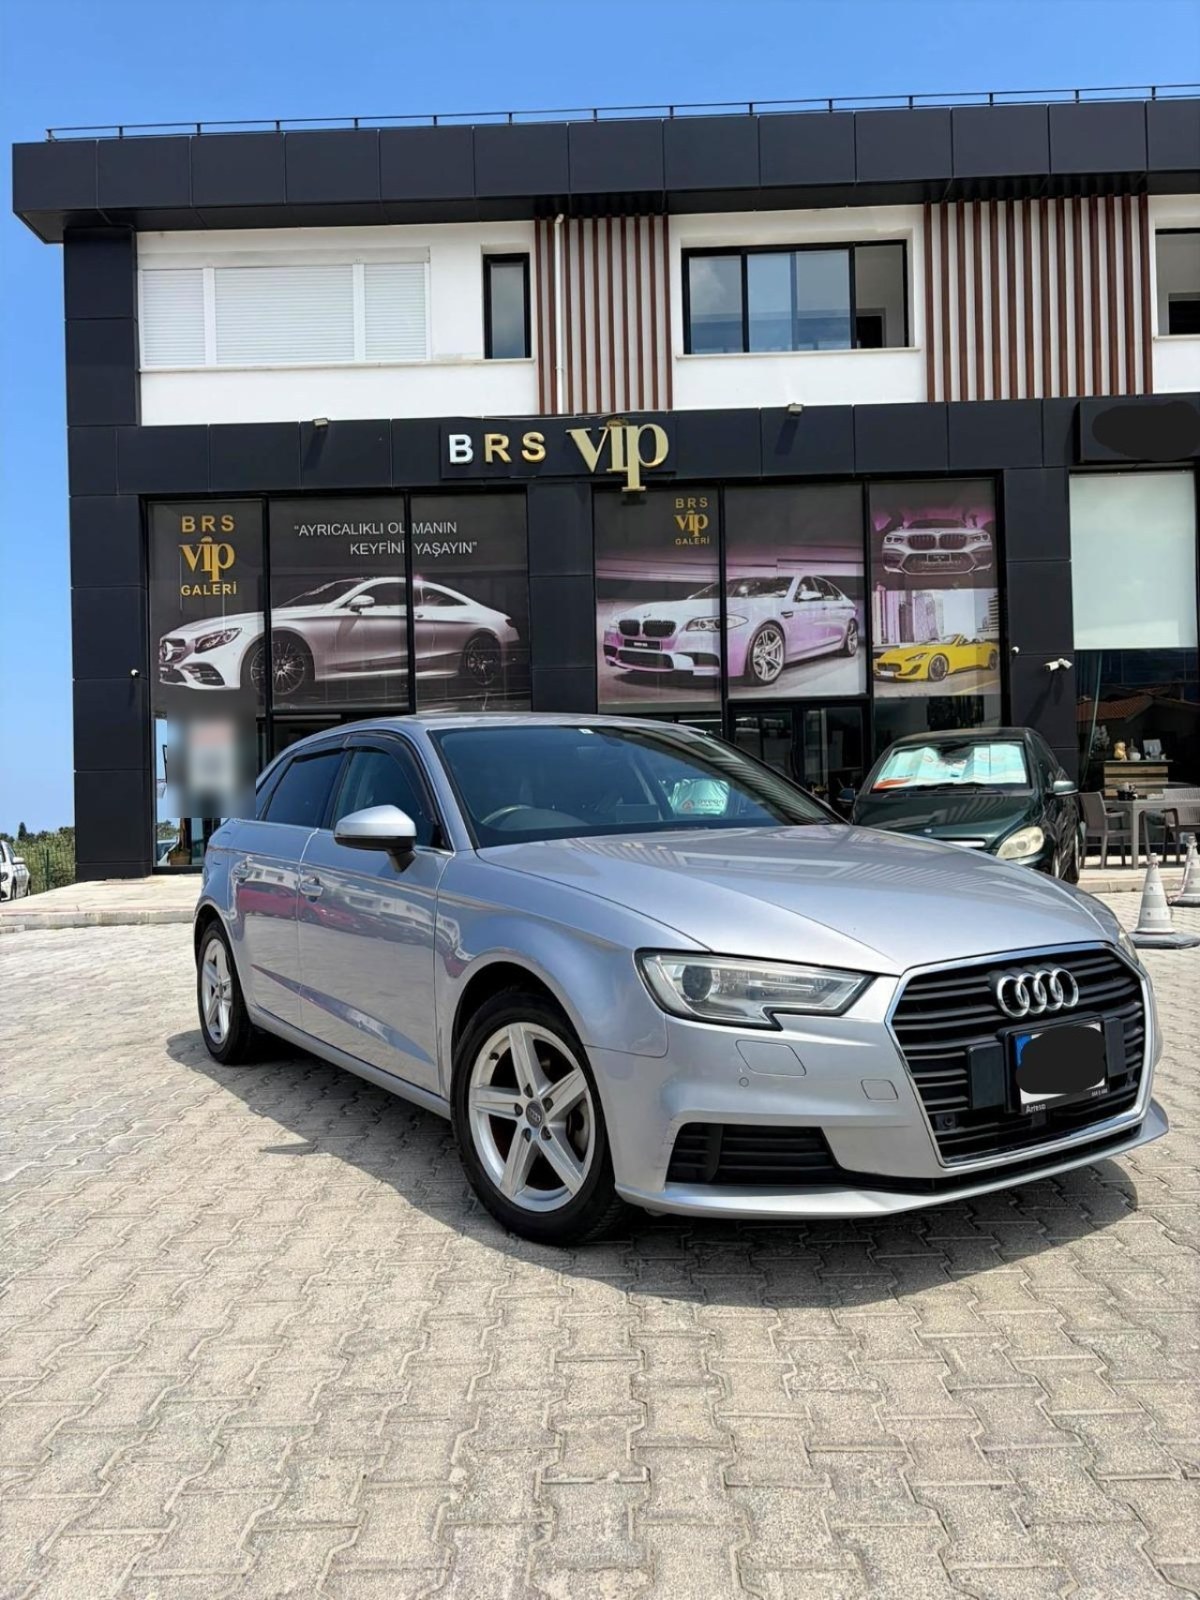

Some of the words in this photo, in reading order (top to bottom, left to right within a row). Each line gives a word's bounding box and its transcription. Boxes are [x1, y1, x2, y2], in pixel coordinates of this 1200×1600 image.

[449, 432, 546, 464] BRS
[675, 497, 708, 509] BRS
[181, 514, 235, 533] BRS
[350, 540, 405, 556] KEYFİNİ
[675, 536, 710, 546] GALERİ
[181, 581, 237, 596] GALERİ
